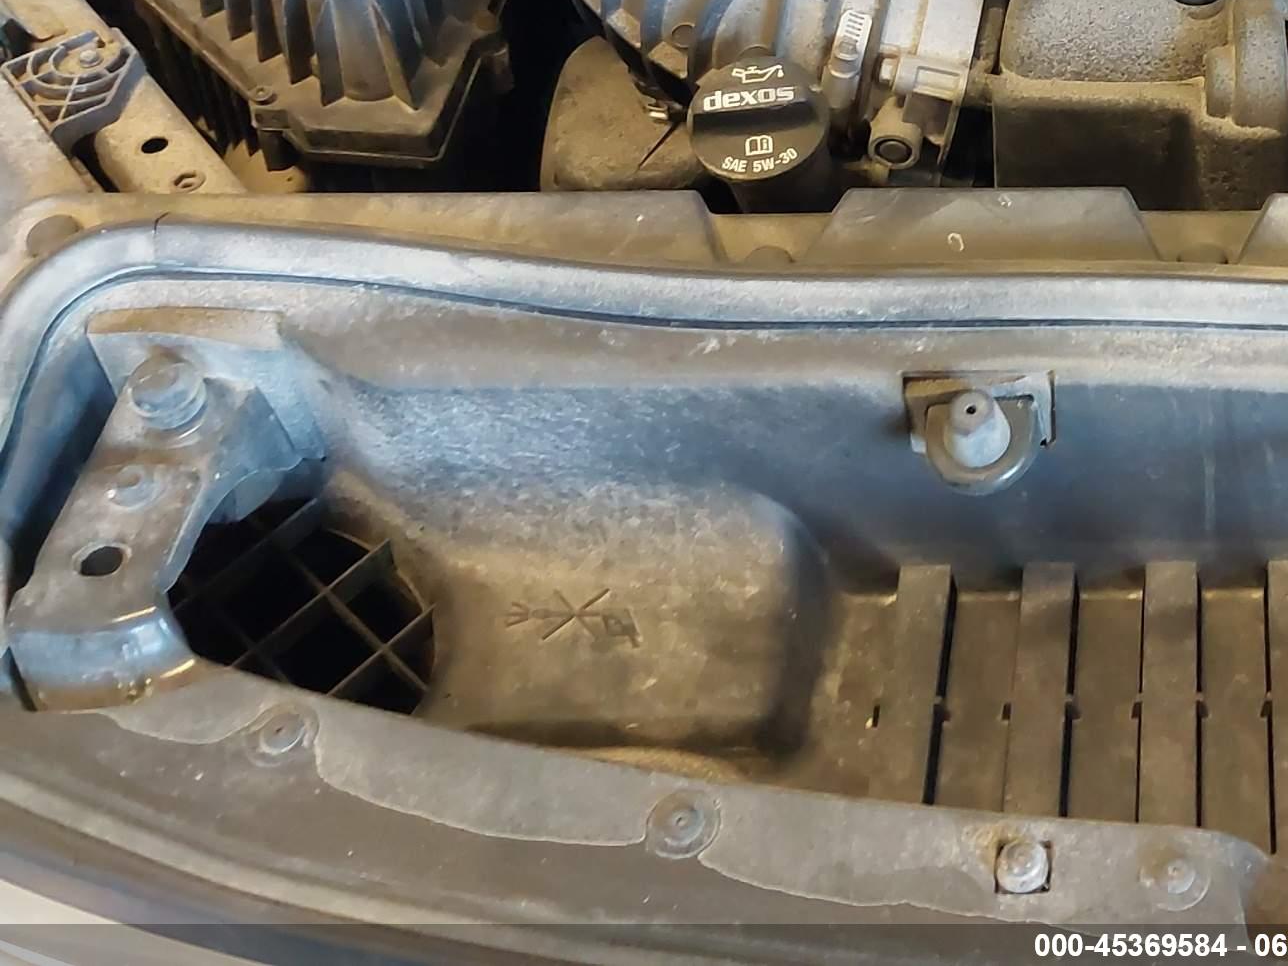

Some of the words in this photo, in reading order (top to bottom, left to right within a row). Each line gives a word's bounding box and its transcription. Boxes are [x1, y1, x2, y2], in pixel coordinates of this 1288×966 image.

[703, 87, 796, 112] dexos
[721, 156, 748, 173] SAE
[752, 147, 798, 173] 5W-30
